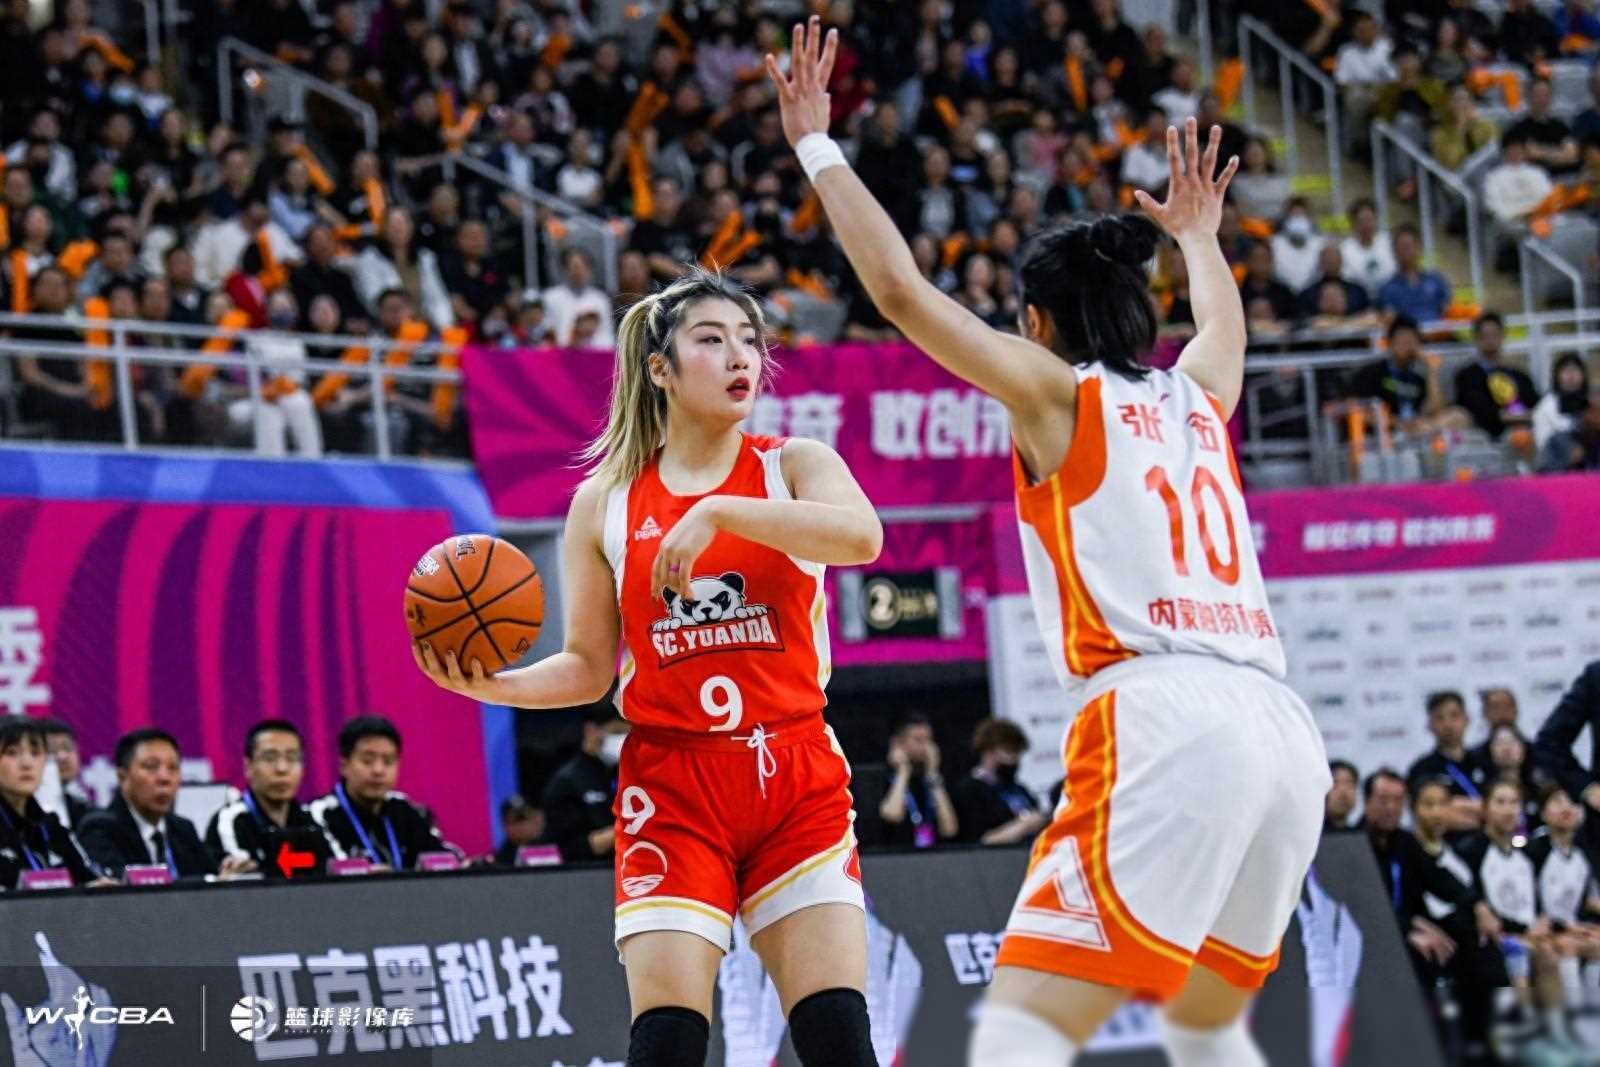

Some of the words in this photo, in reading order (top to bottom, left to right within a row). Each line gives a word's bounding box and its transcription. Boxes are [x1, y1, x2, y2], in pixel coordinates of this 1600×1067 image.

[1144, 464, 1240, 587] 10
[652, 614, 777, 658] SC.YUANDA
[700, 674, 744, 733] 9
[621, 785, 656, 836] 9
[237, 933, 575, 1062] 匹克黑科技
